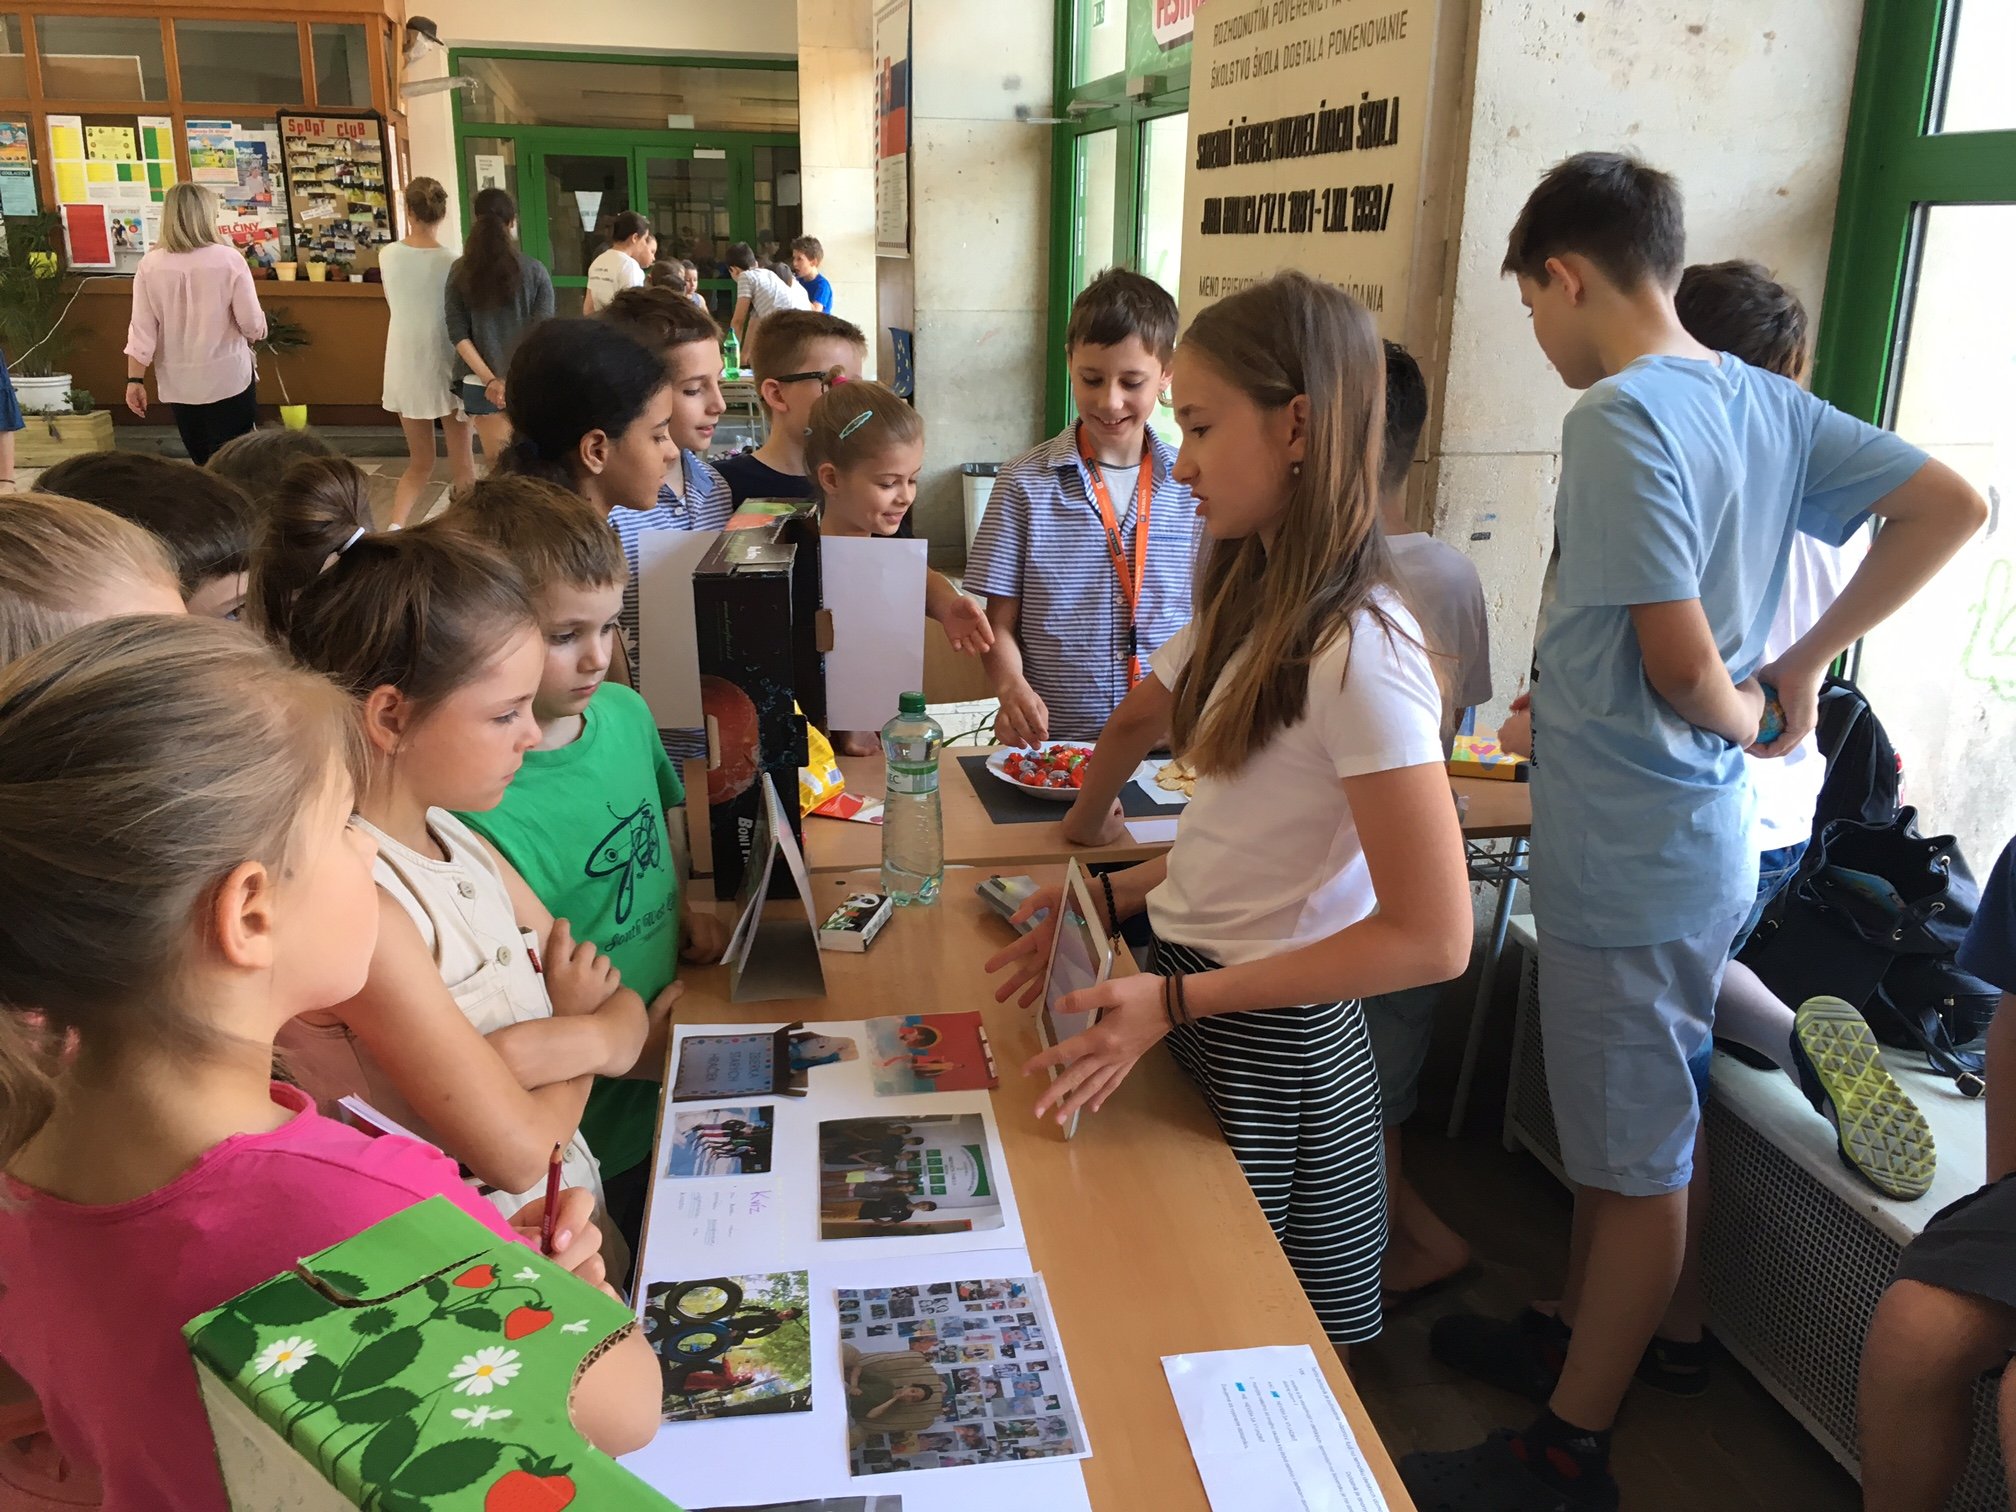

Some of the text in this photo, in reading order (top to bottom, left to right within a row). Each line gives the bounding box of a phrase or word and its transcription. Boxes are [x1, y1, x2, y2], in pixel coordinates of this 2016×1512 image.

[1210, 9, 1409, 89] ŠKOLSTVO ŠKOLA DOSTALA POMENOVANIE
[337, 121, 366, 138] CLUB
[218, 222, 259, 235] IELČINY
[1199, 276, 1219, 297] MENO
